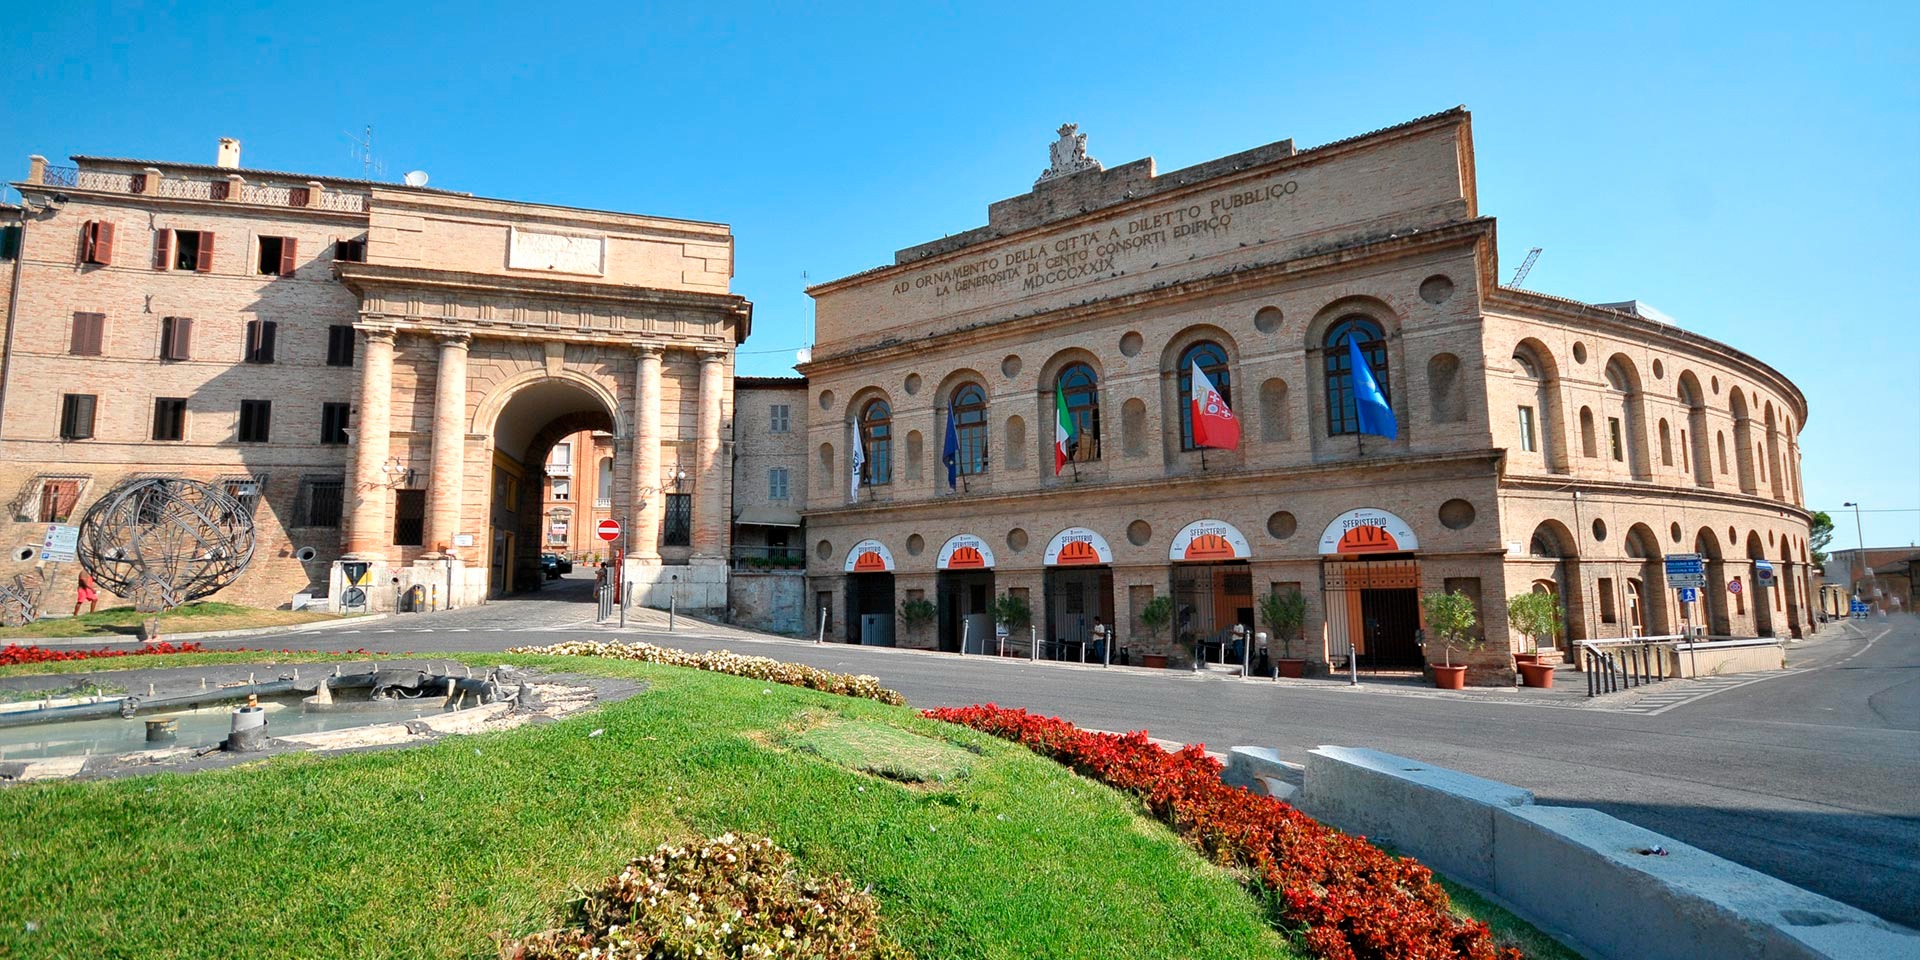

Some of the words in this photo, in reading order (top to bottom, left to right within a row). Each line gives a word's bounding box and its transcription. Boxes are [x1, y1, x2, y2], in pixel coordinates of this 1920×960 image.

[893, 281, 910, 296] AD
[916, 258, 999, 289] ORNAMENTO
[1006, 246, 1048, 266] DELLA
[1109, 227, 1119, 240] A
[1129, 205, 1201, 235] DILETTO
[1211, 181, 1298, 214] PUBBLICO
[937, 286, 950, 297] LA
[1027, 262, 1039, 275] DI
[1046, 249, 1089, 270] CENTO
[1096, 230, 1166, 257] CONSORTI
[1342, 517, 1387, 529] SFERISTERIO
[1061, 534, 1093, 543] SFERISTERIO
[1190, 527, 1227, 537] SFERISTERIO
[1343, 525, 1389, 543] LIVE
[1062, 541, 1093, 556] LIVE
[1190, 535, 1228, 550] LIVE
[858, 552, 881, 564] LIVE
[952, 547, 980, 560] LIVE
